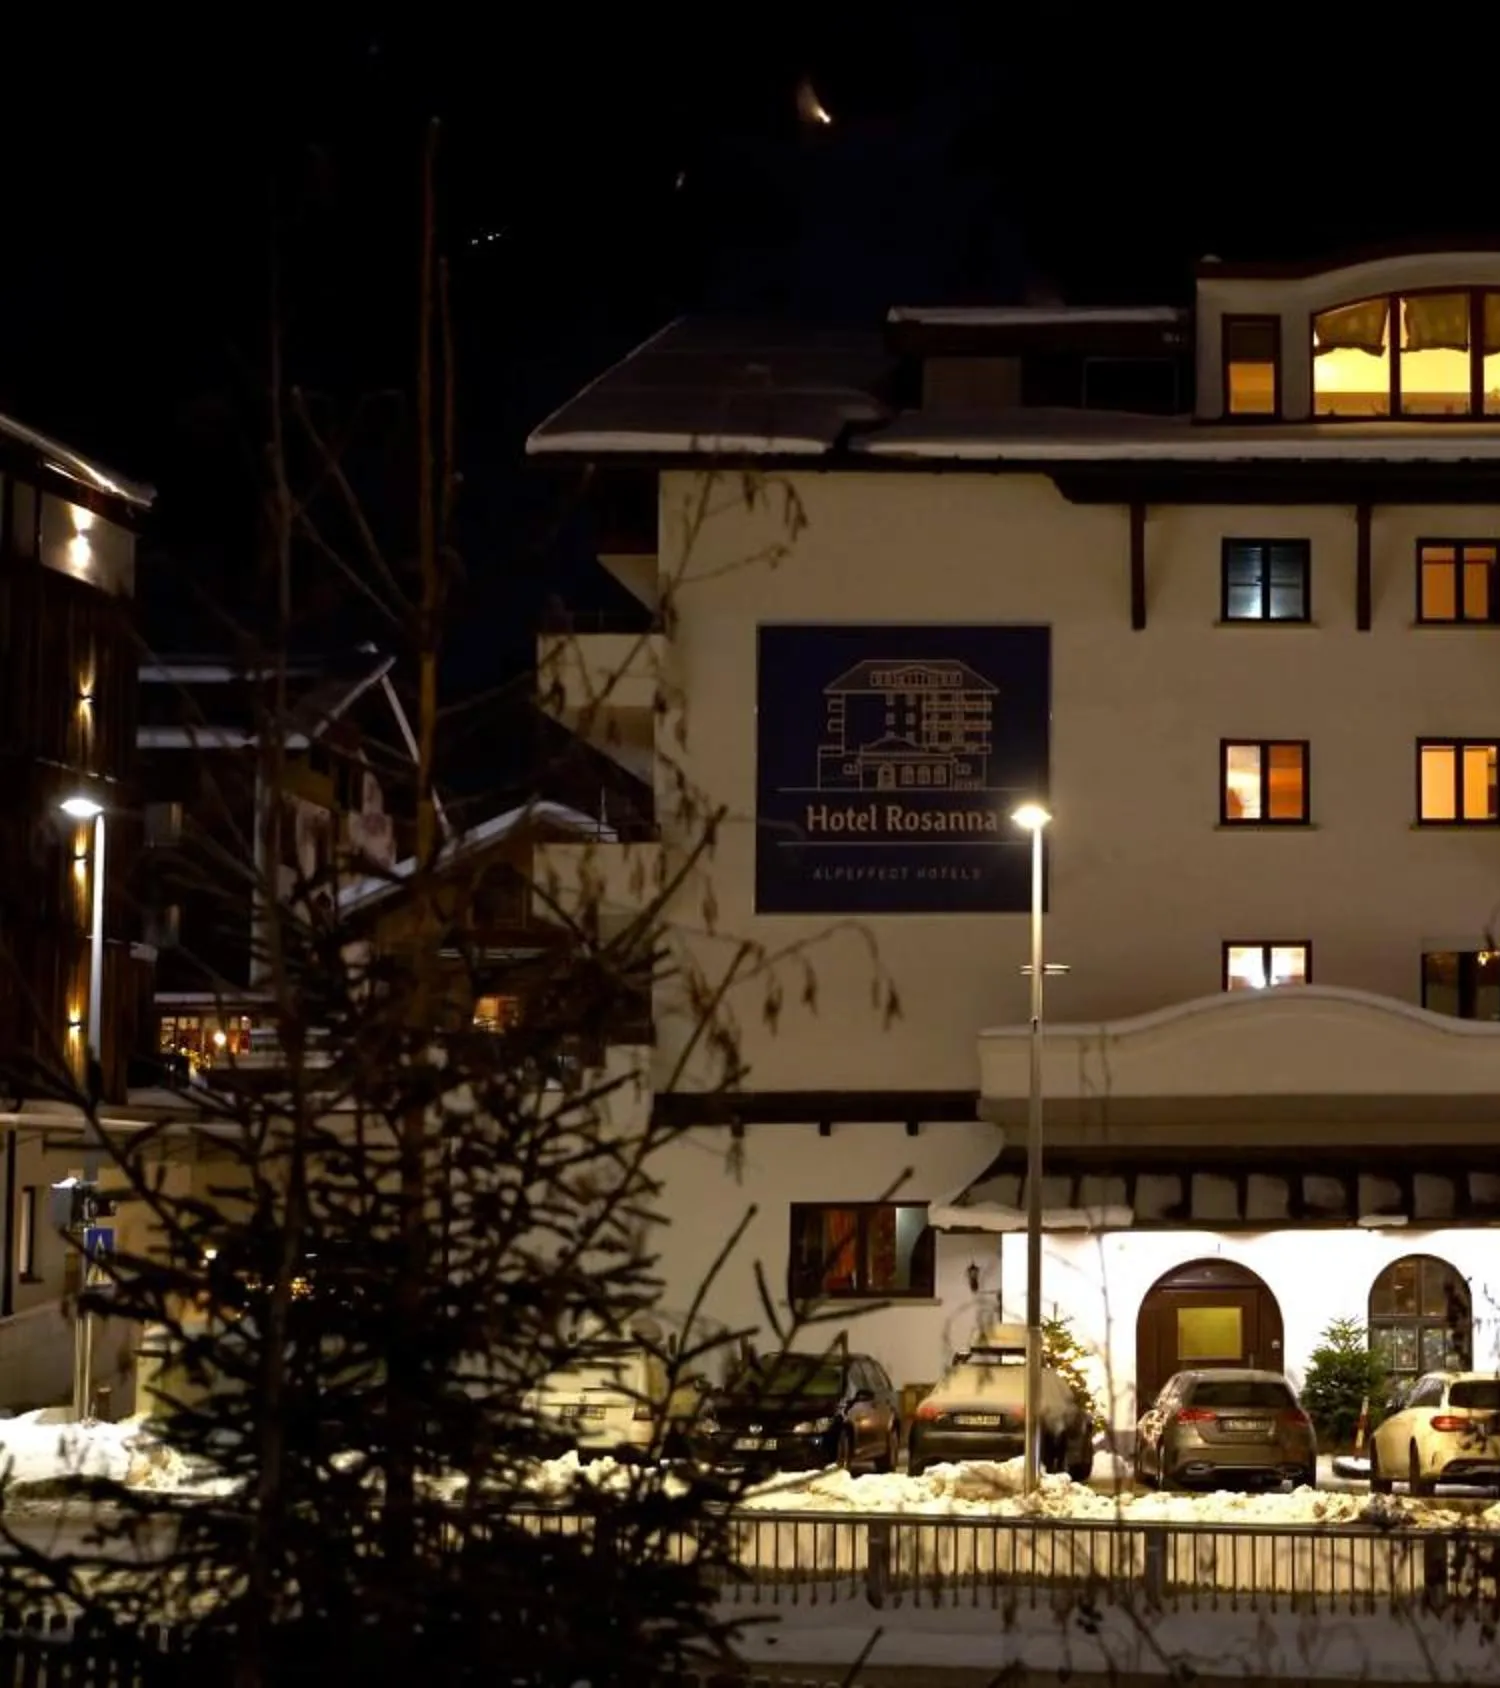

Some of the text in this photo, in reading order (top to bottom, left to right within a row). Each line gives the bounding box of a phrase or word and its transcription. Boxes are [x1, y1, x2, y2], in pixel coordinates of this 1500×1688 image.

[806, 803, 998, 832] Hotel Rosanna
[812, 865, 982, 880] ALPEFFECT HOTELS
